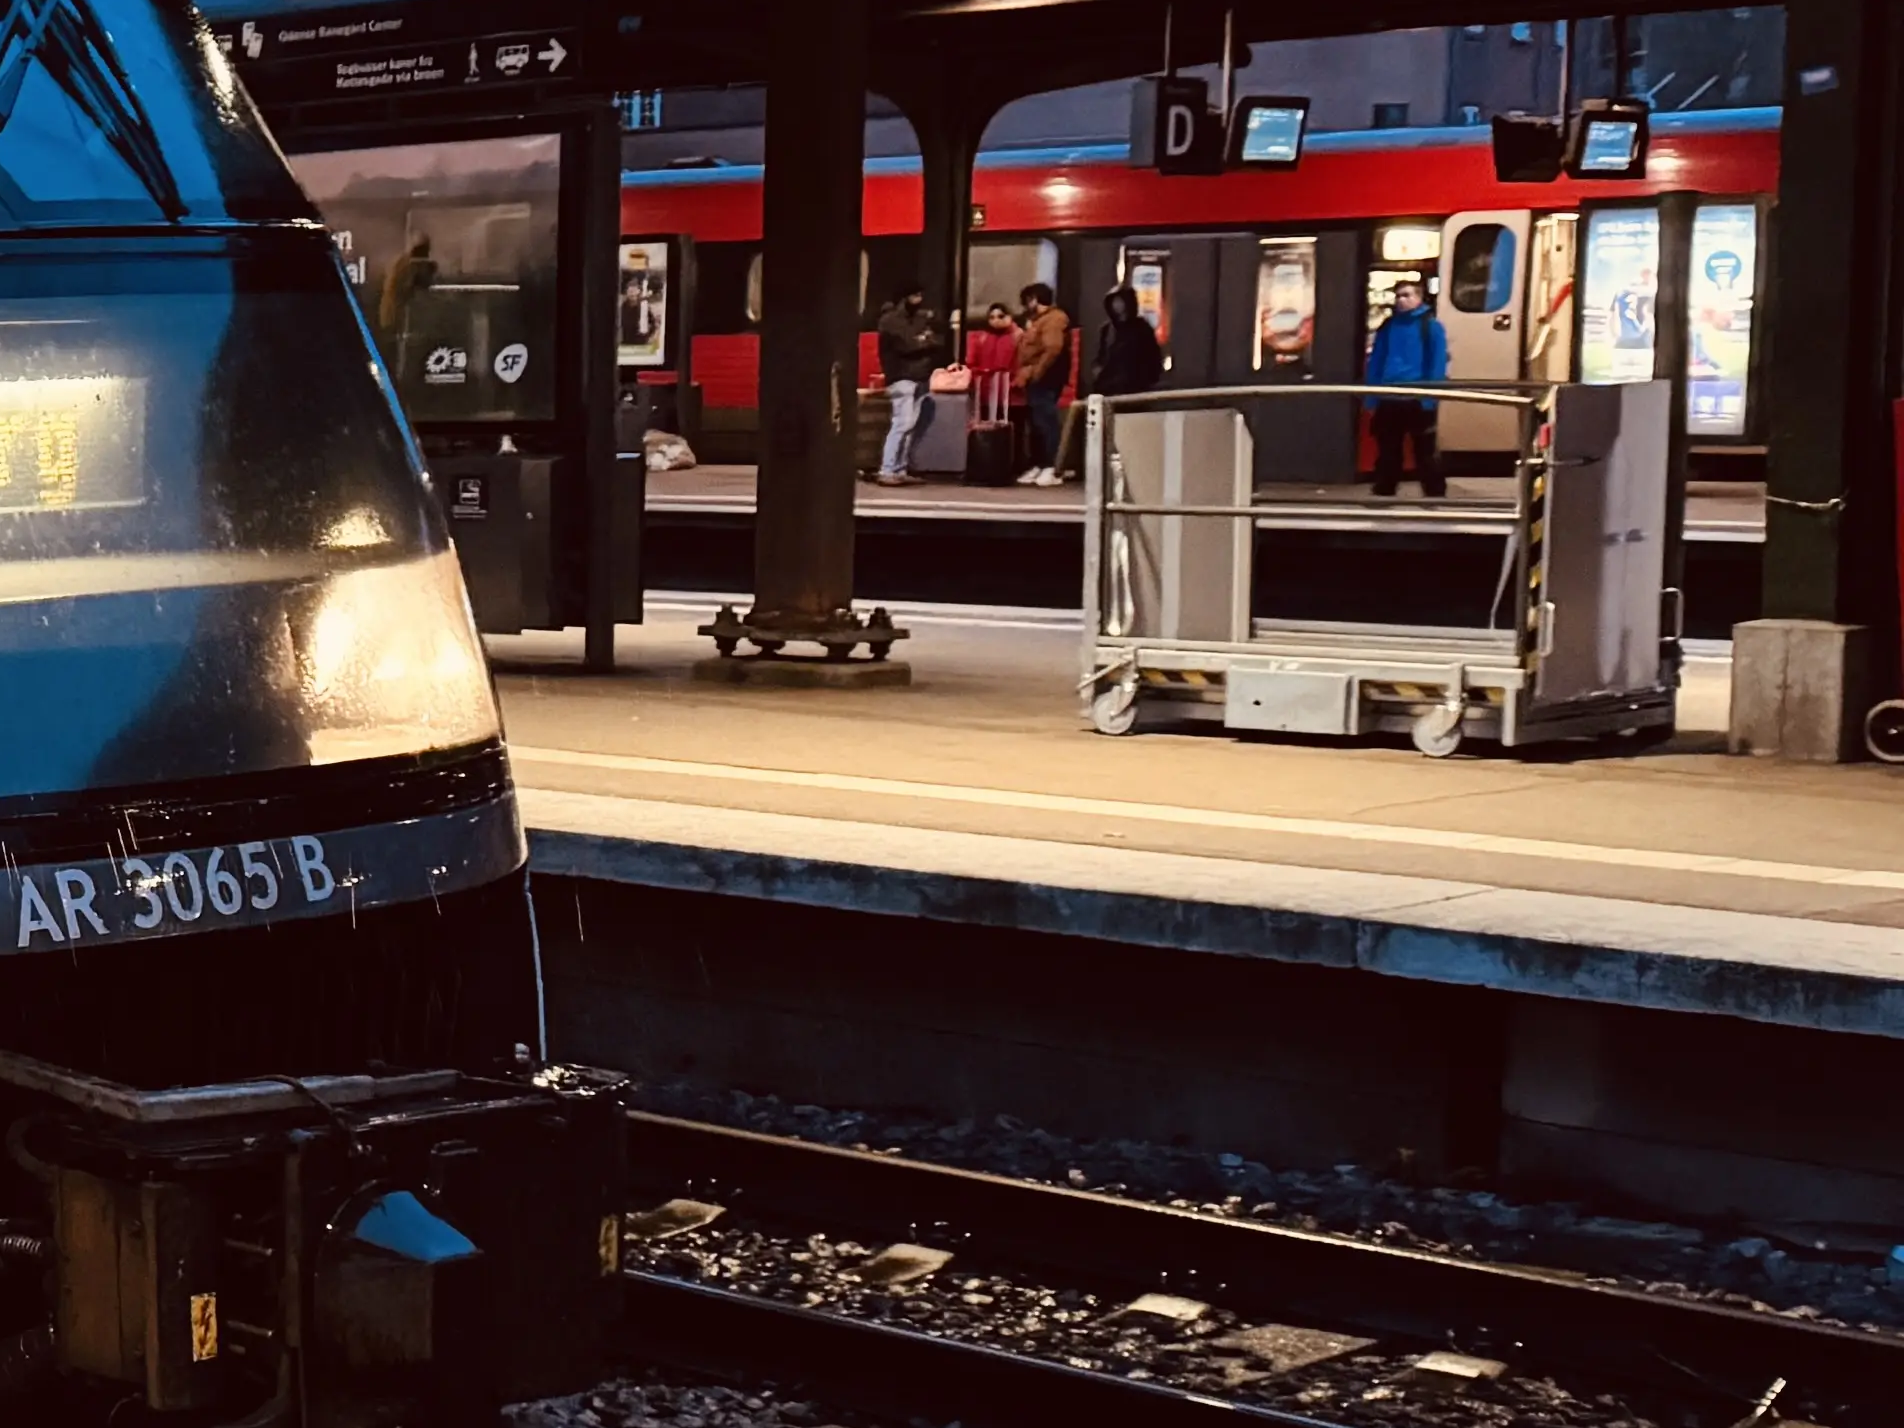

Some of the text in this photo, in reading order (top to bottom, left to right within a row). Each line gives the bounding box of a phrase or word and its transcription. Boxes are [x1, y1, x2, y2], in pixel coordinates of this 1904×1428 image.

[1166, 105, 1193, 156] D
[500, 353, 522, 372] SF
[17, 835, 336, 948] AR 3065 B
